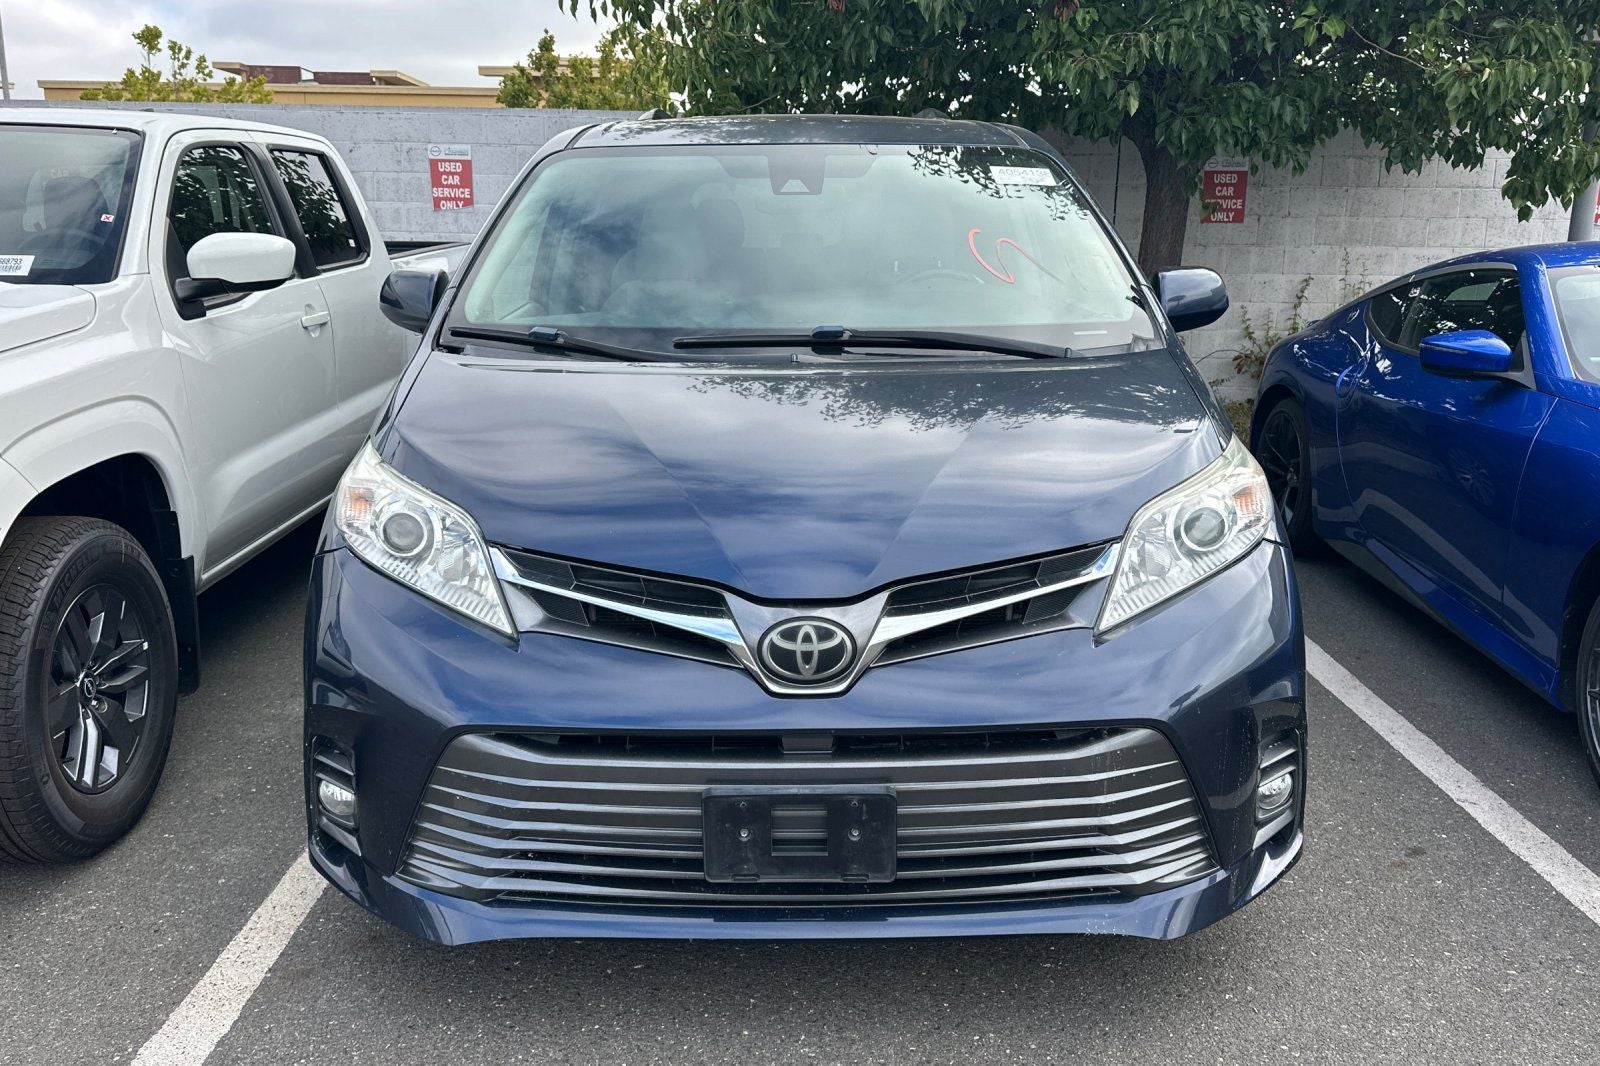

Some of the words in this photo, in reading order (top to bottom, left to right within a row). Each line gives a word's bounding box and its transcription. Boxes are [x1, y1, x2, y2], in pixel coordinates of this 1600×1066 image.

[437, 162, 463, 172] USED
[441, 175, 460, 185] CAR
[1213, 173, 1238, 184] USED
[432, 187, 471, 198] SERVICE
[1215, 186, 1234, 196] CAR
[440, 200, 464, 210] ONLY
[1205, 199, 1243, 209] VICE
[1210, 211, 1235, 222] ONLY
